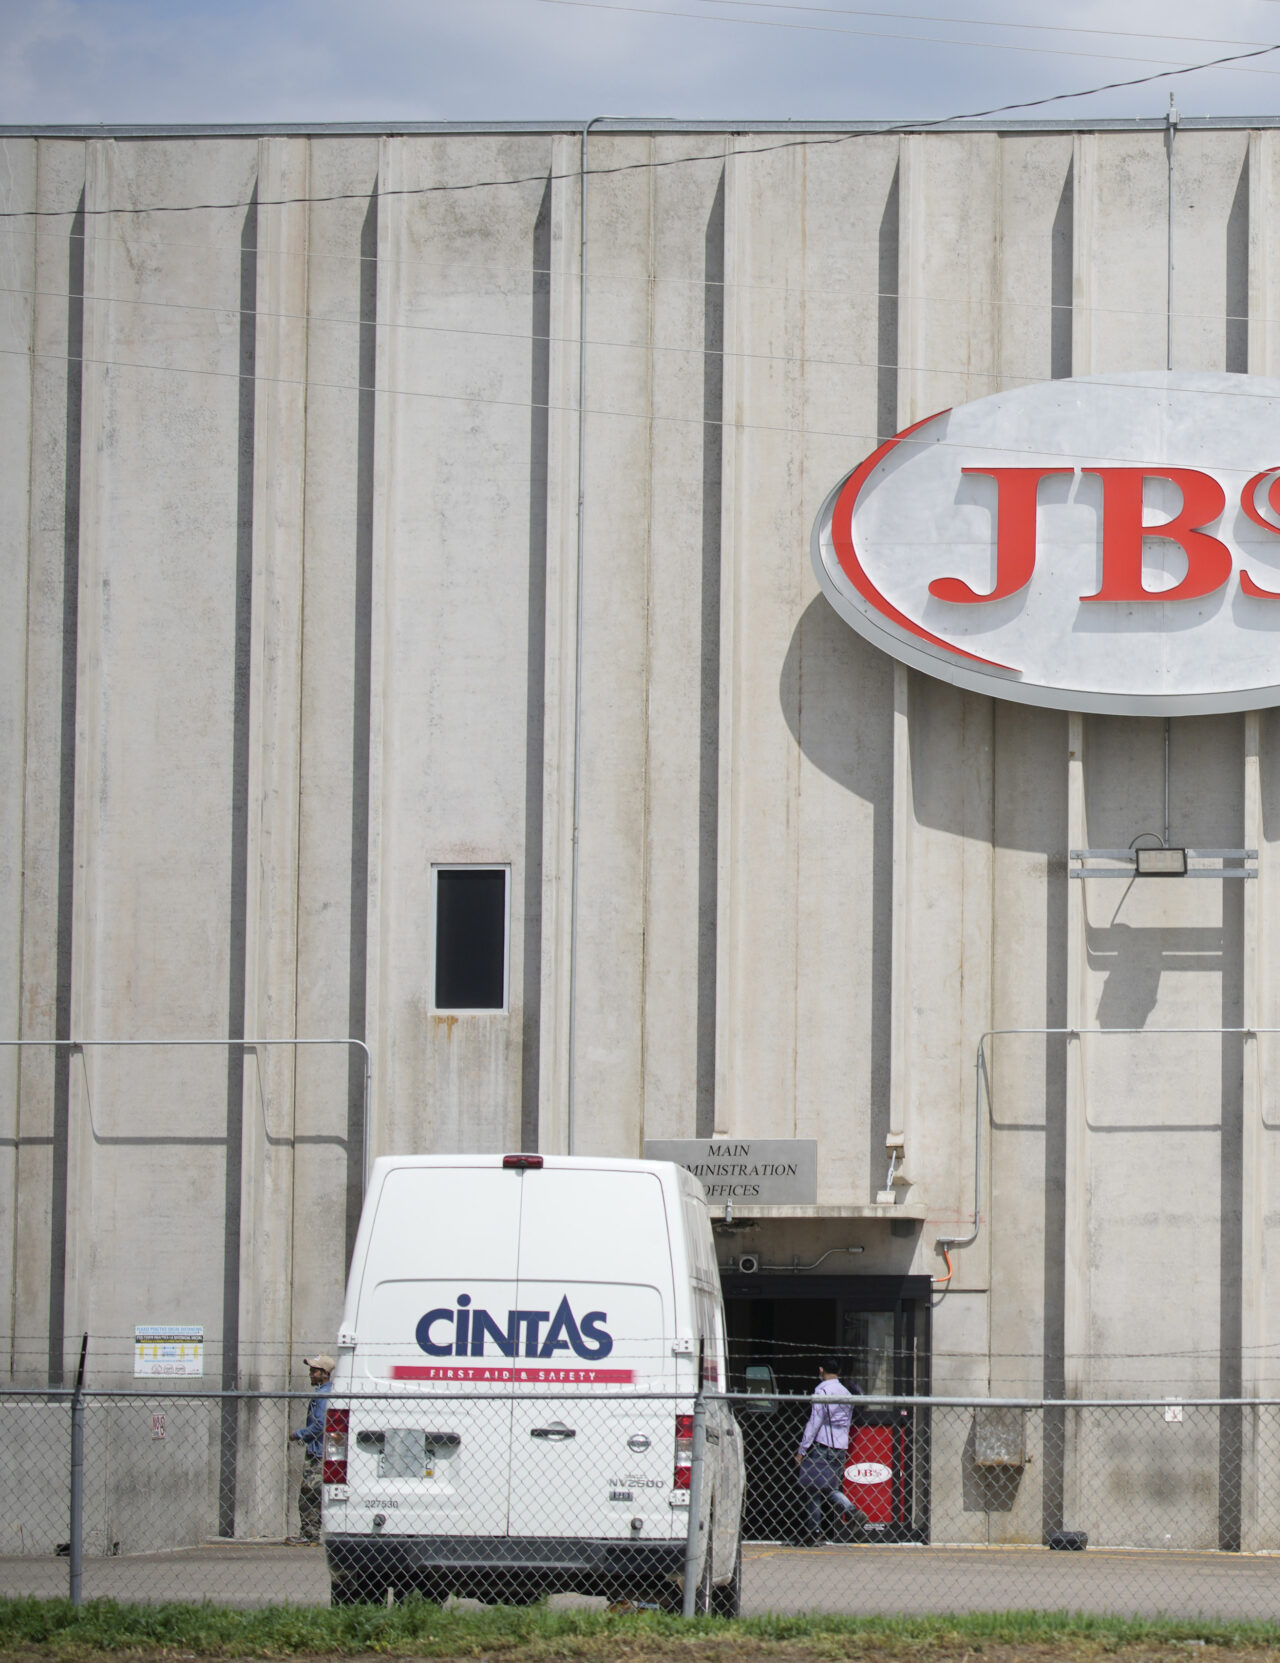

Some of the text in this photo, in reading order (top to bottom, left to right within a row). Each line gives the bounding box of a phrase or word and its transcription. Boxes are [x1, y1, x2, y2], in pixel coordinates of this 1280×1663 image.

[708, 1144, 751, 1157] MAIN
[682, 1164, 798, 1177] MINISTRATION
[430, 1369, 597, 1381] FIRST AID & SAFETY
